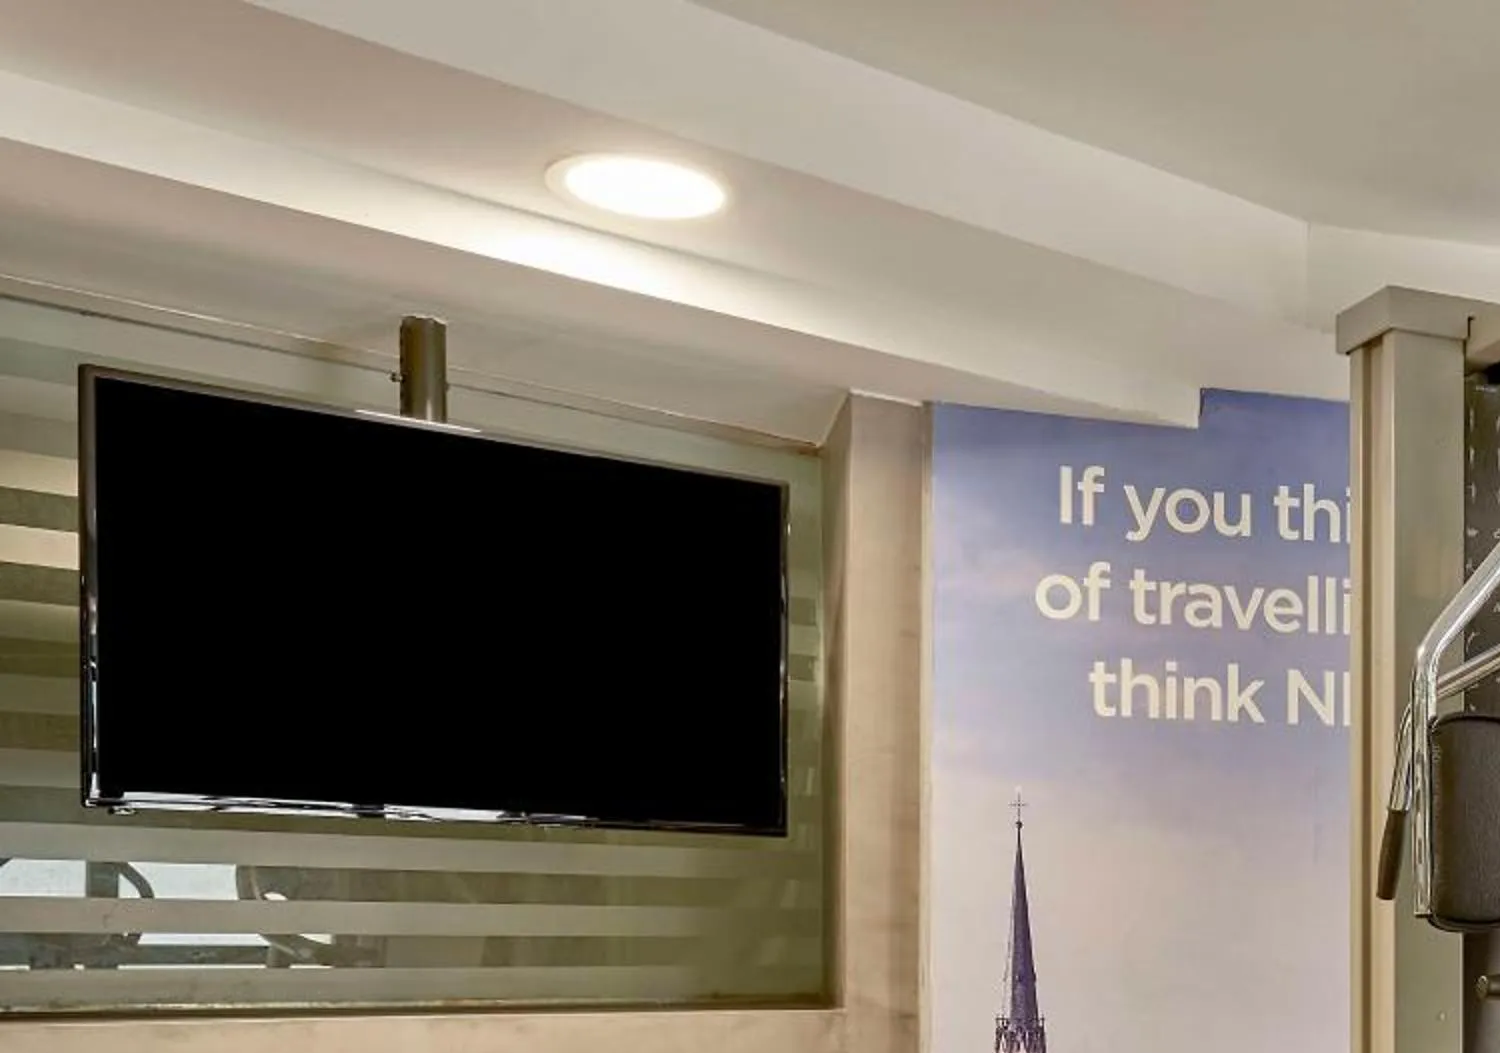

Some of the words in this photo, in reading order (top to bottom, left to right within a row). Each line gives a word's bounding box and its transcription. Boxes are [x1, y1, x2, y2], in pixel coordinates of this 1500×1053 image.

[1059, 465, 1105, 526] If
[1123, 484, 1252, 542] you
[1035, 561, 1111, 622] of
[1088, 658, 1265, 724] think
[1287, 669, 1350, 727] N
